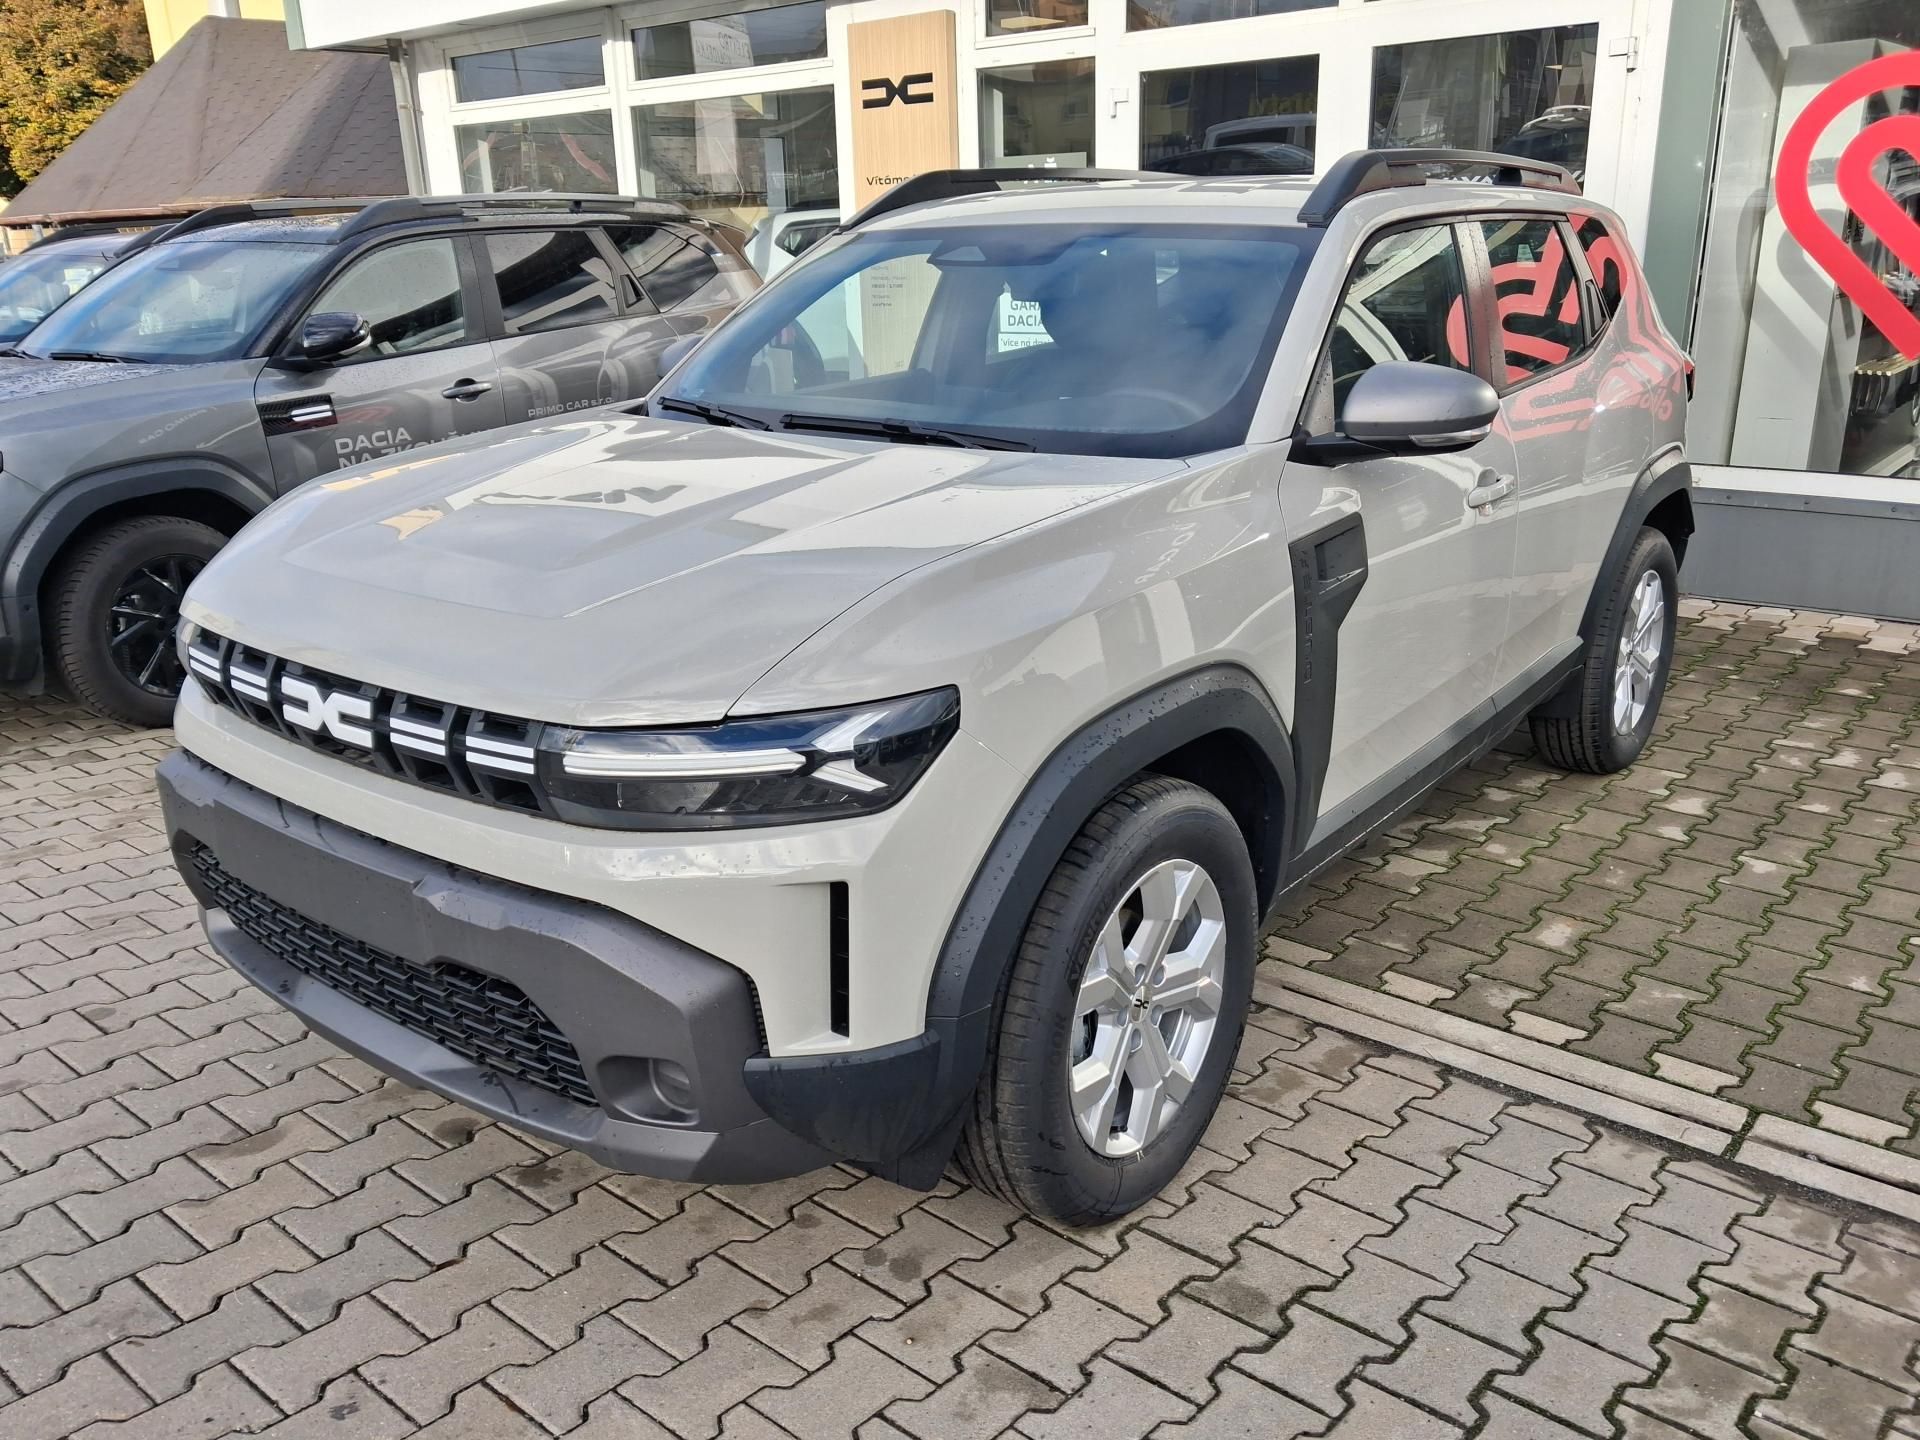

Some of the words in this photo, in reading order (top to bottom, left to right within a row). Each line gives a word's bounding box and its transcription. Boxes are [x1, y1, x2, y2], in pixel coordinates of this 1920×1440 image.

[527, 404, 564, 418] PRIMO
[566, 399, 589, 411] CAR
[334, 427, 412, 454] DACIA
